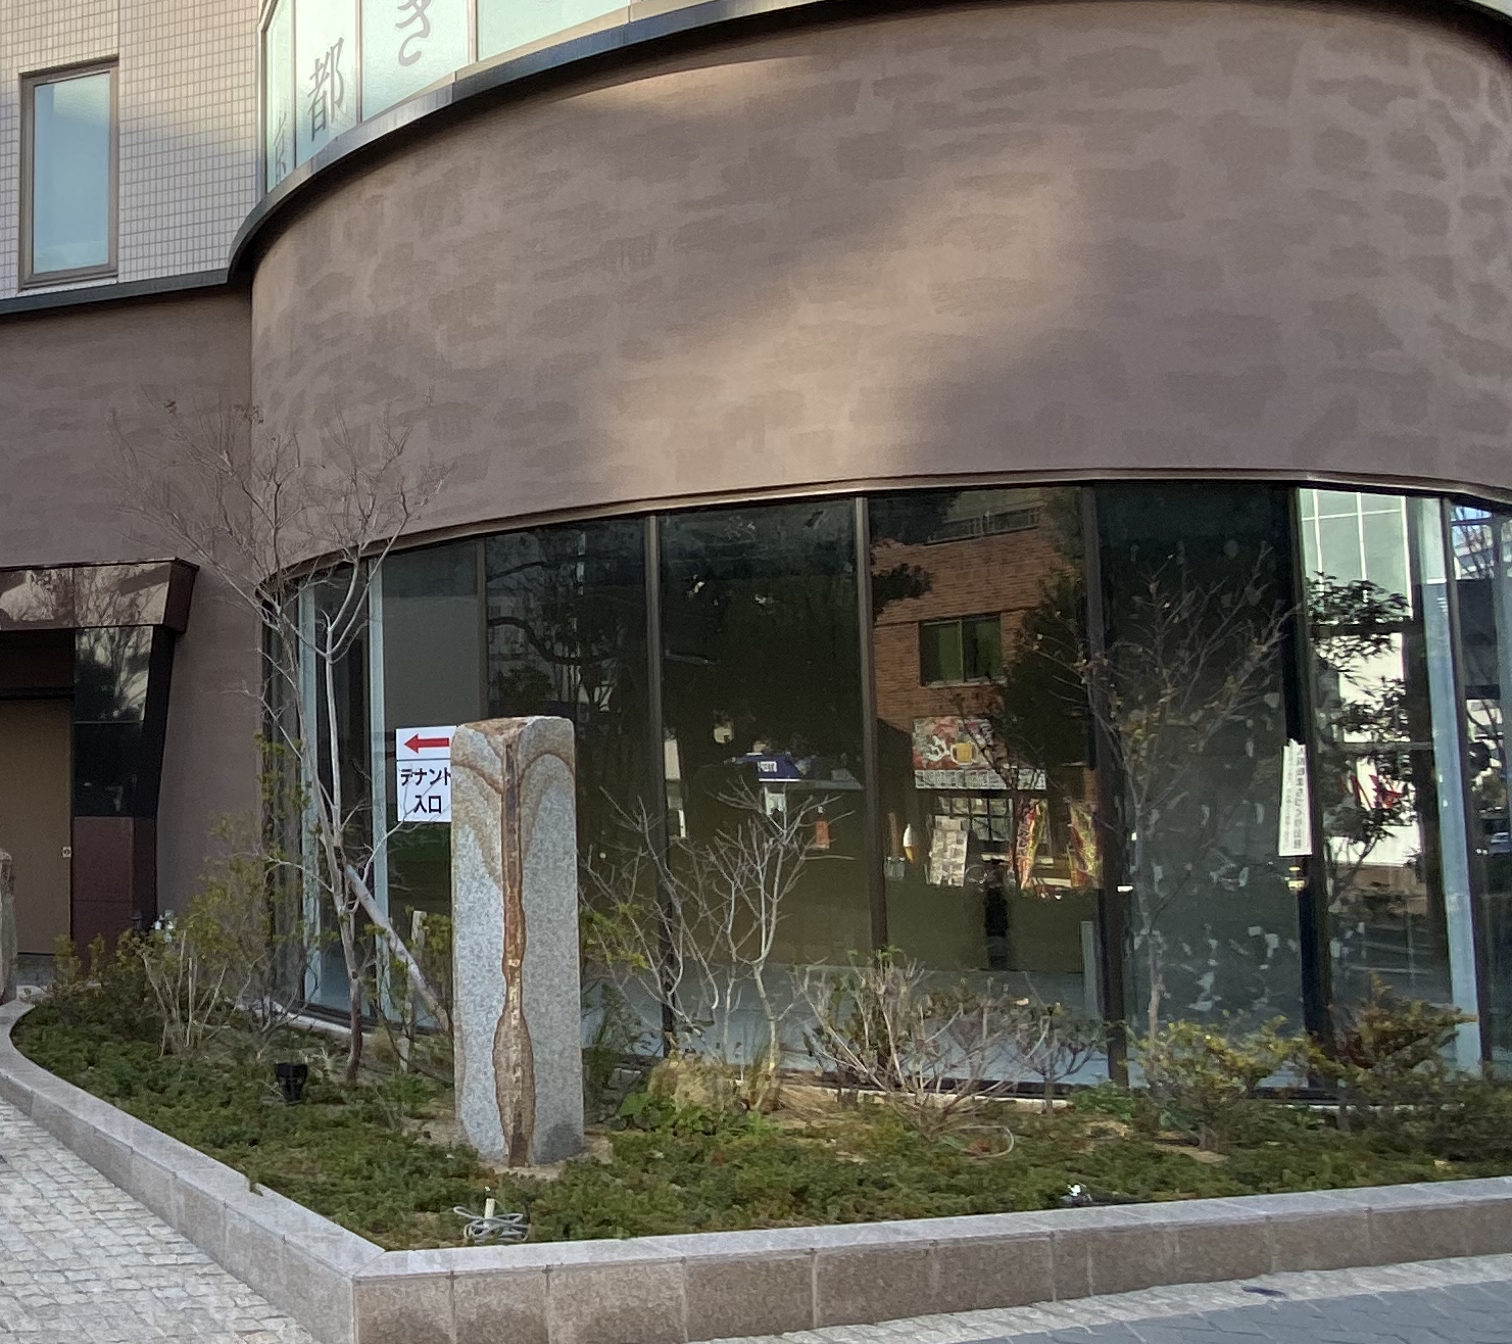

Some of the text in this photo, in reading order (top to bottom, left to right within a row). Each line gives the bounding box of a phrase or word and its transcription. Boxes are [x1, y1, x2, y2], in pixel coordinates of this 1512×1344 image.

[400, 766, 451, 787] テナント
[414, 794, 442, 814] 入口
